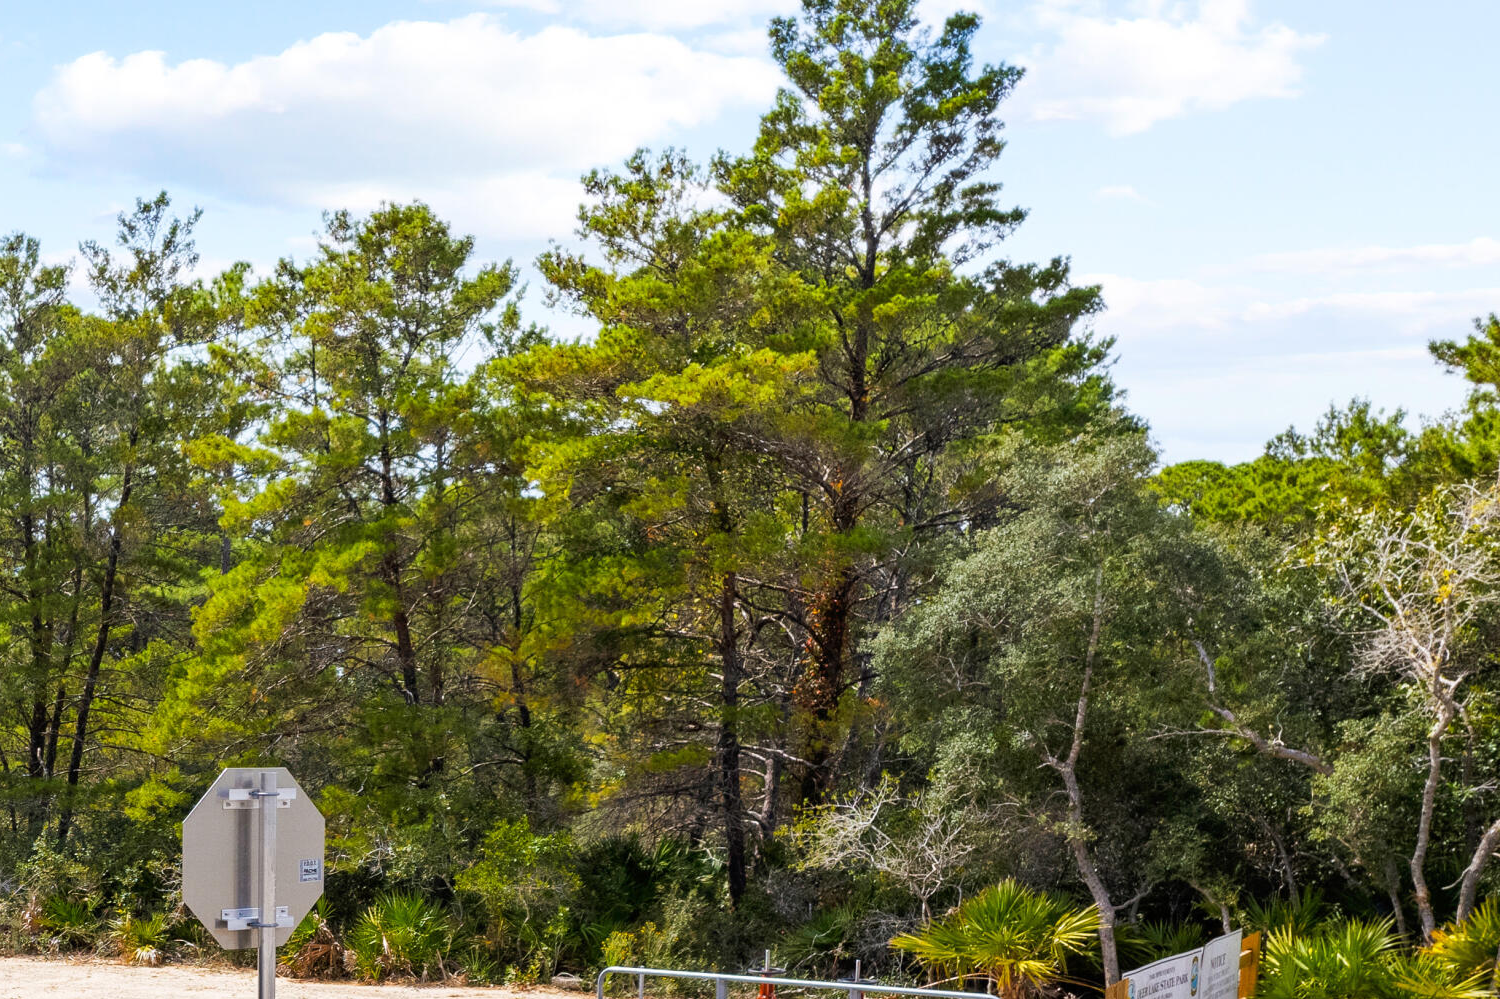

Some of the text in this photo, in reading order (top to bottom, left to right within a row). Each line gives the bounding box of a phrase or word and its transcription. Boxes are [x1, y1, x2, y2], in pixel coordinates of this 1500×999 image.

[1148, 982, 1160, 995] LAKE
[1159, 977, 1176, 991] STATE
[1175, 973, 1189, 986] PARK
